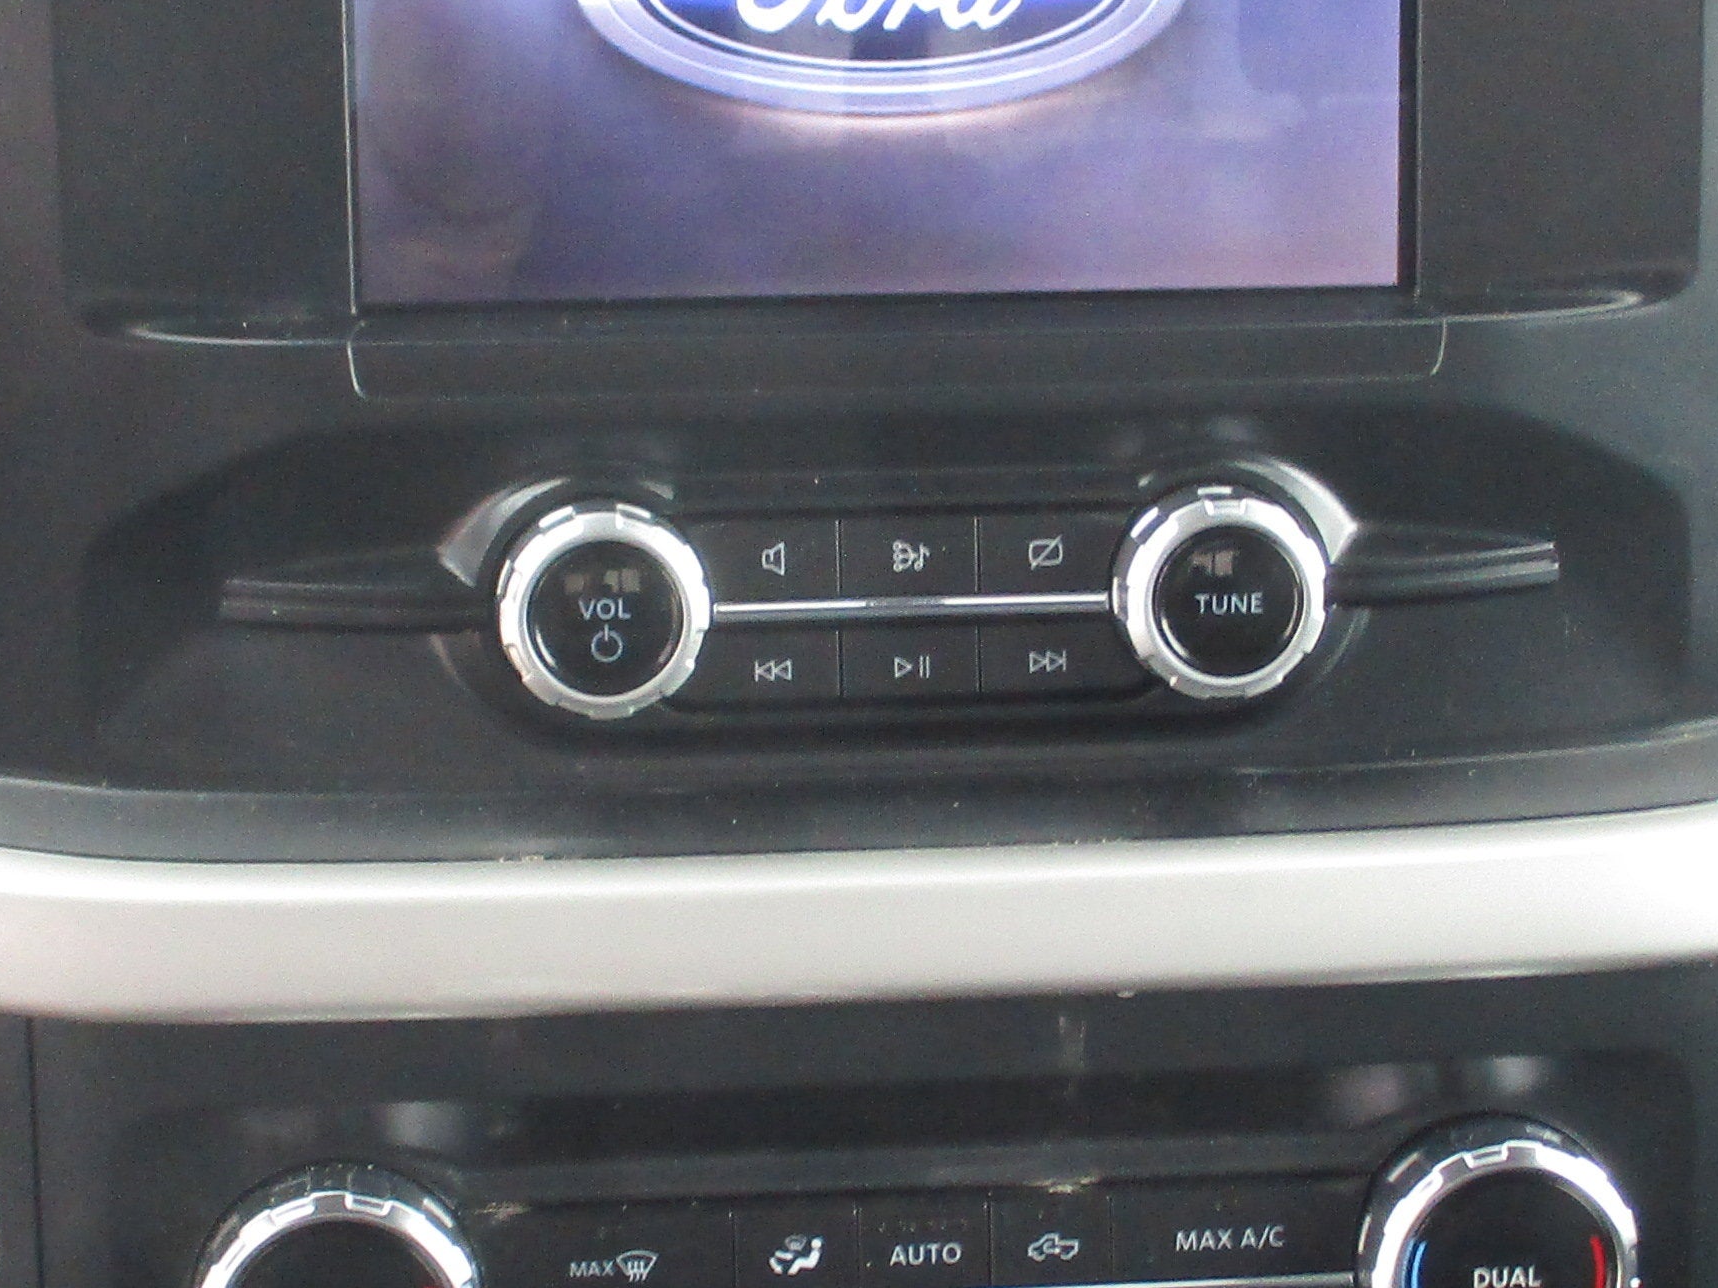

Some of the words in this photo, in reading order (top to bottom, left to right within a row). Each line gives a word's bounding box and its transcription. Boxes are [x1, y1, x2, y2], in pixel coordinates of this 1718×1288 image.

[578, 597, 632, 621] VOL
[1194, 591, 1264, 616] TUNE
[1176, 1227, 1232, 1252] MAX
[1240, 1224, 1285, 1250] A/C
[889, 1241, 963, 1267] AUTO
[569, 1259, 615, 1278] MAX
